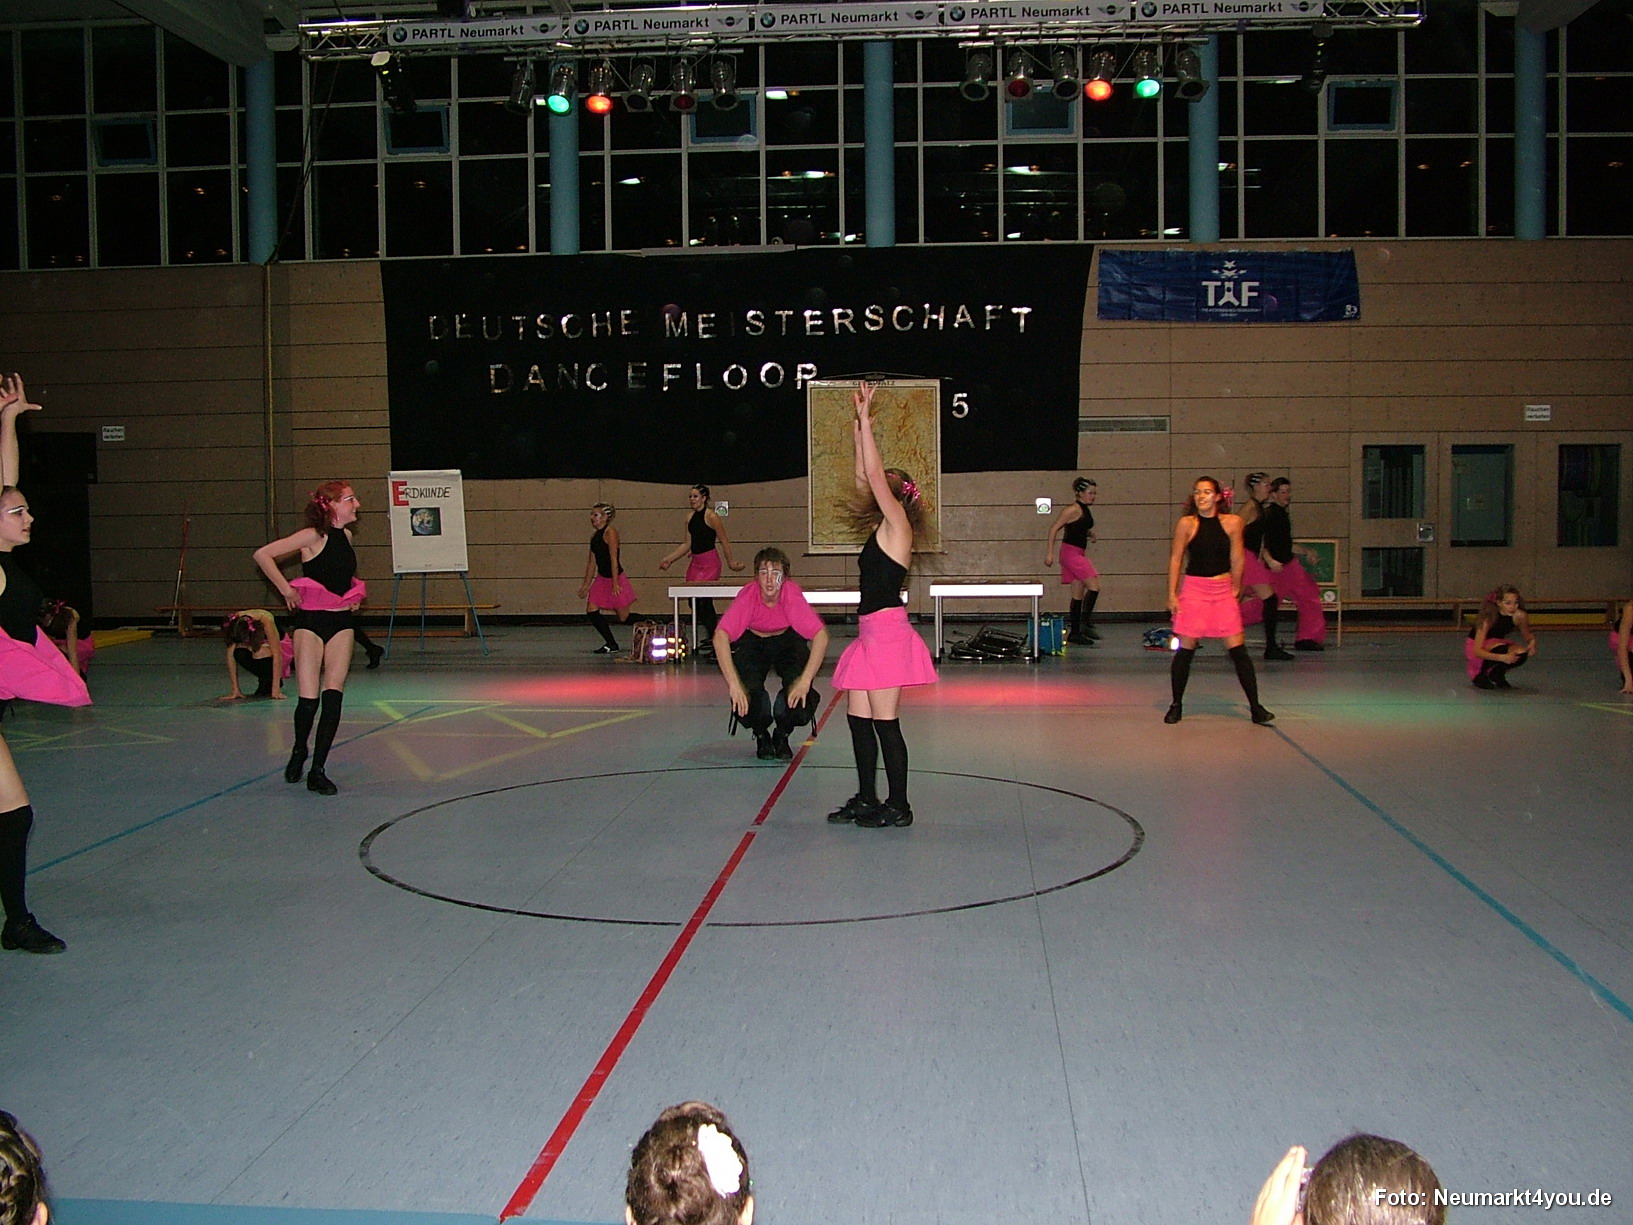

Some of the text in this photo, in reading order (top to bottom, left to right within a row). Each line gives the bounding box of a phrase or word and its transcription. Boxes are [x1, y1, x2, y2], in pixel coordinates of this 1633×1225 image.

[971, 5, 1090, 18] PARTL Neumarkt
[1162, 2, 1283, 14] PARTL Neumarkt
[594, 17, 709, 31] PARTL Neumarkt
[781, 11, 899, 25] PARTL Neumarkt
[412, 25, 525, 39] PARTL Neumarkt
[428, 303, 1032, 340] DEUTSCHE MEISTERSCHAFT
[392, 481, 451, 507] ERDKUNDE
